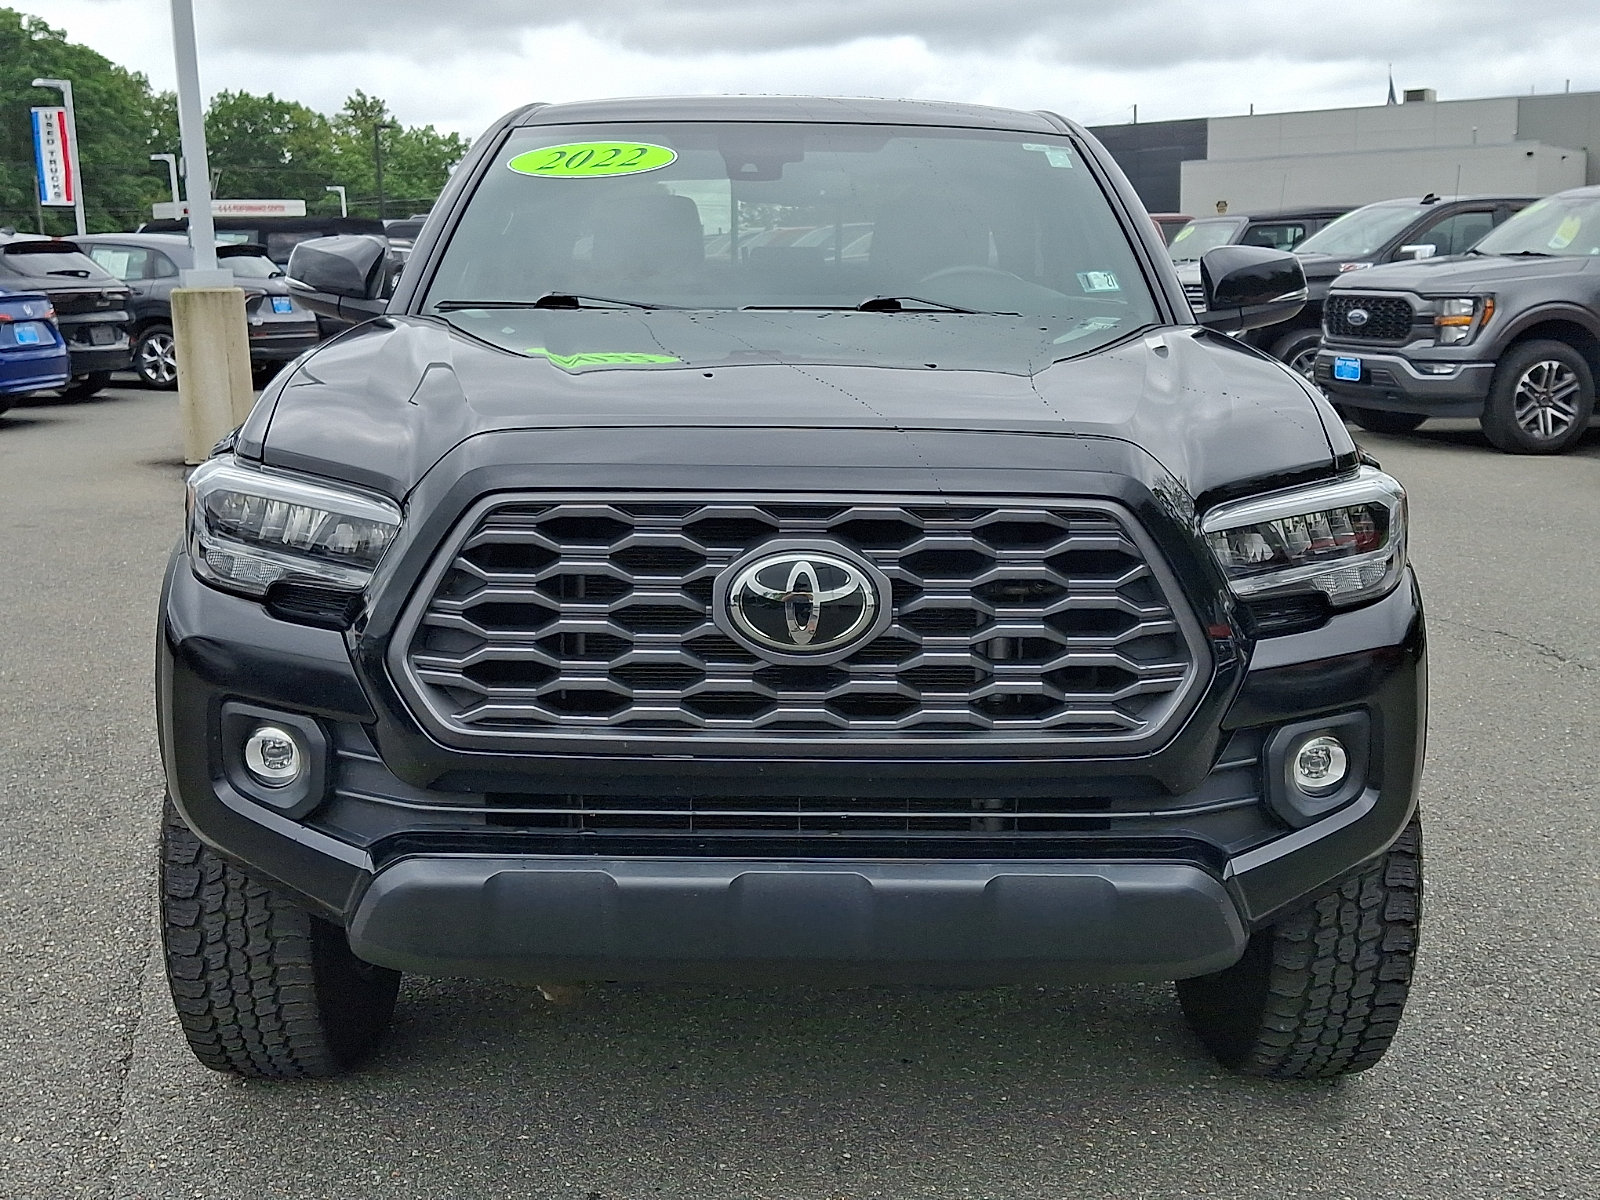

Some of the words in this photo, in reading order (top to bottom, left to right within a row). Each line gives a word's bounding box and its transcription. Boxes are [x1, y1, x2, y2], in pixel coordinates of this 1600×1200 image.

[45, 113, 55, 146] USED
[48, 151, 61, 198] TRUCKS
[535, 147, 648, 171] 2022
